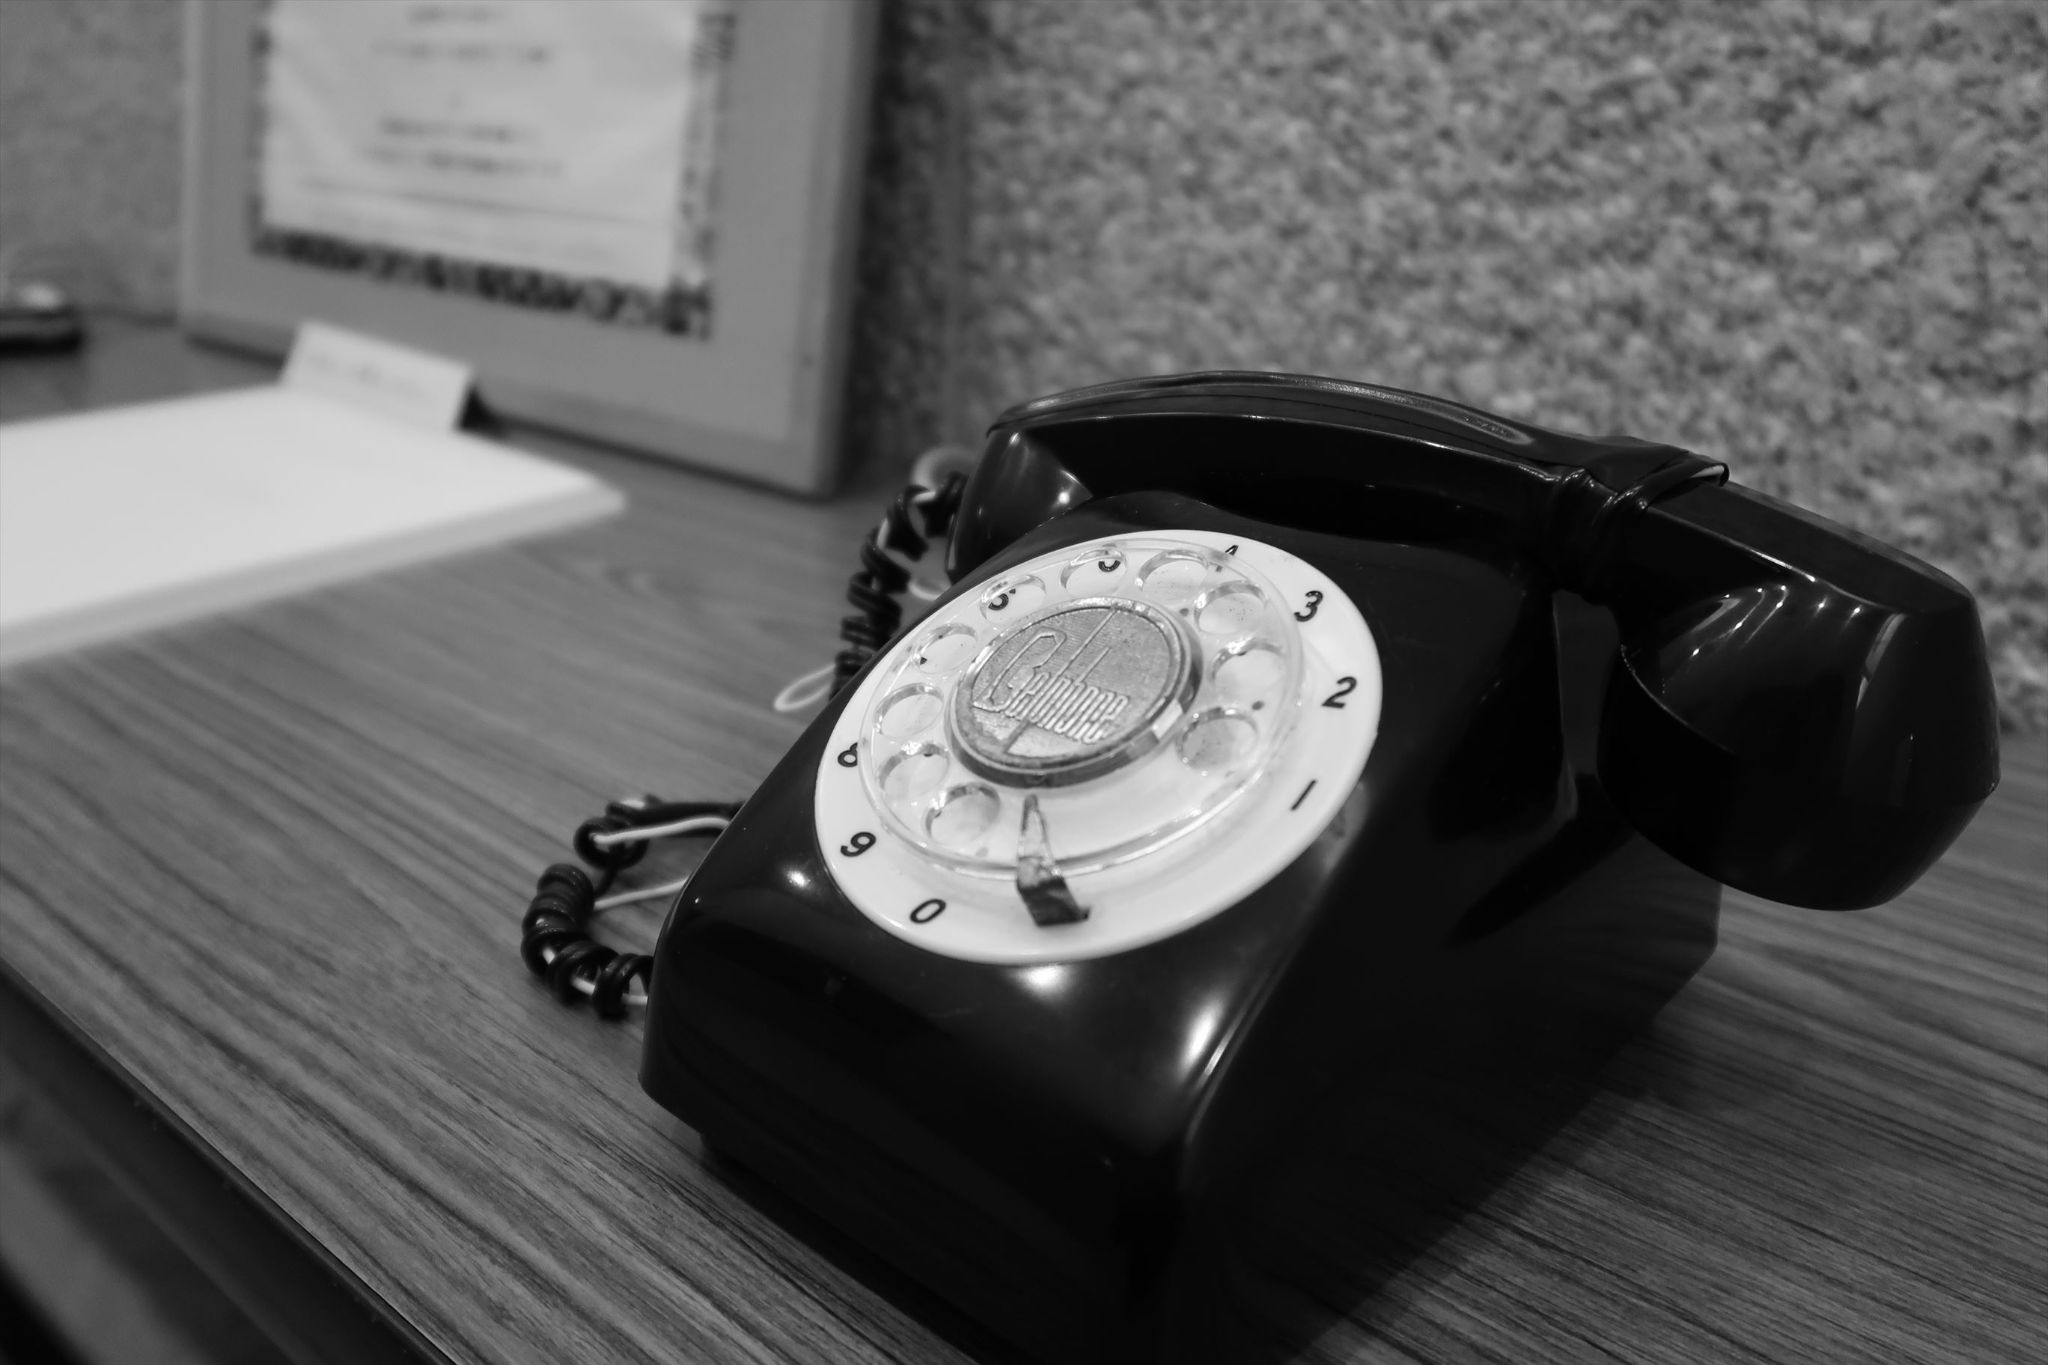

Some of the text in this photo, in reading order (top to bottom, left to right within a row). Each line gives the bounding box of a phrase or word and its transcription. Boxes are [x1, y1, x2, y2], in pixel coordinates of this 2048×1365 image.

[1294, 590, 1324, 622] 3
[1323, 676, 1357, 709] 2
[1291, 779, 1317, 811] 1
[840, 831, 877, 858] 9
[910, 898, 947, 924] 0
